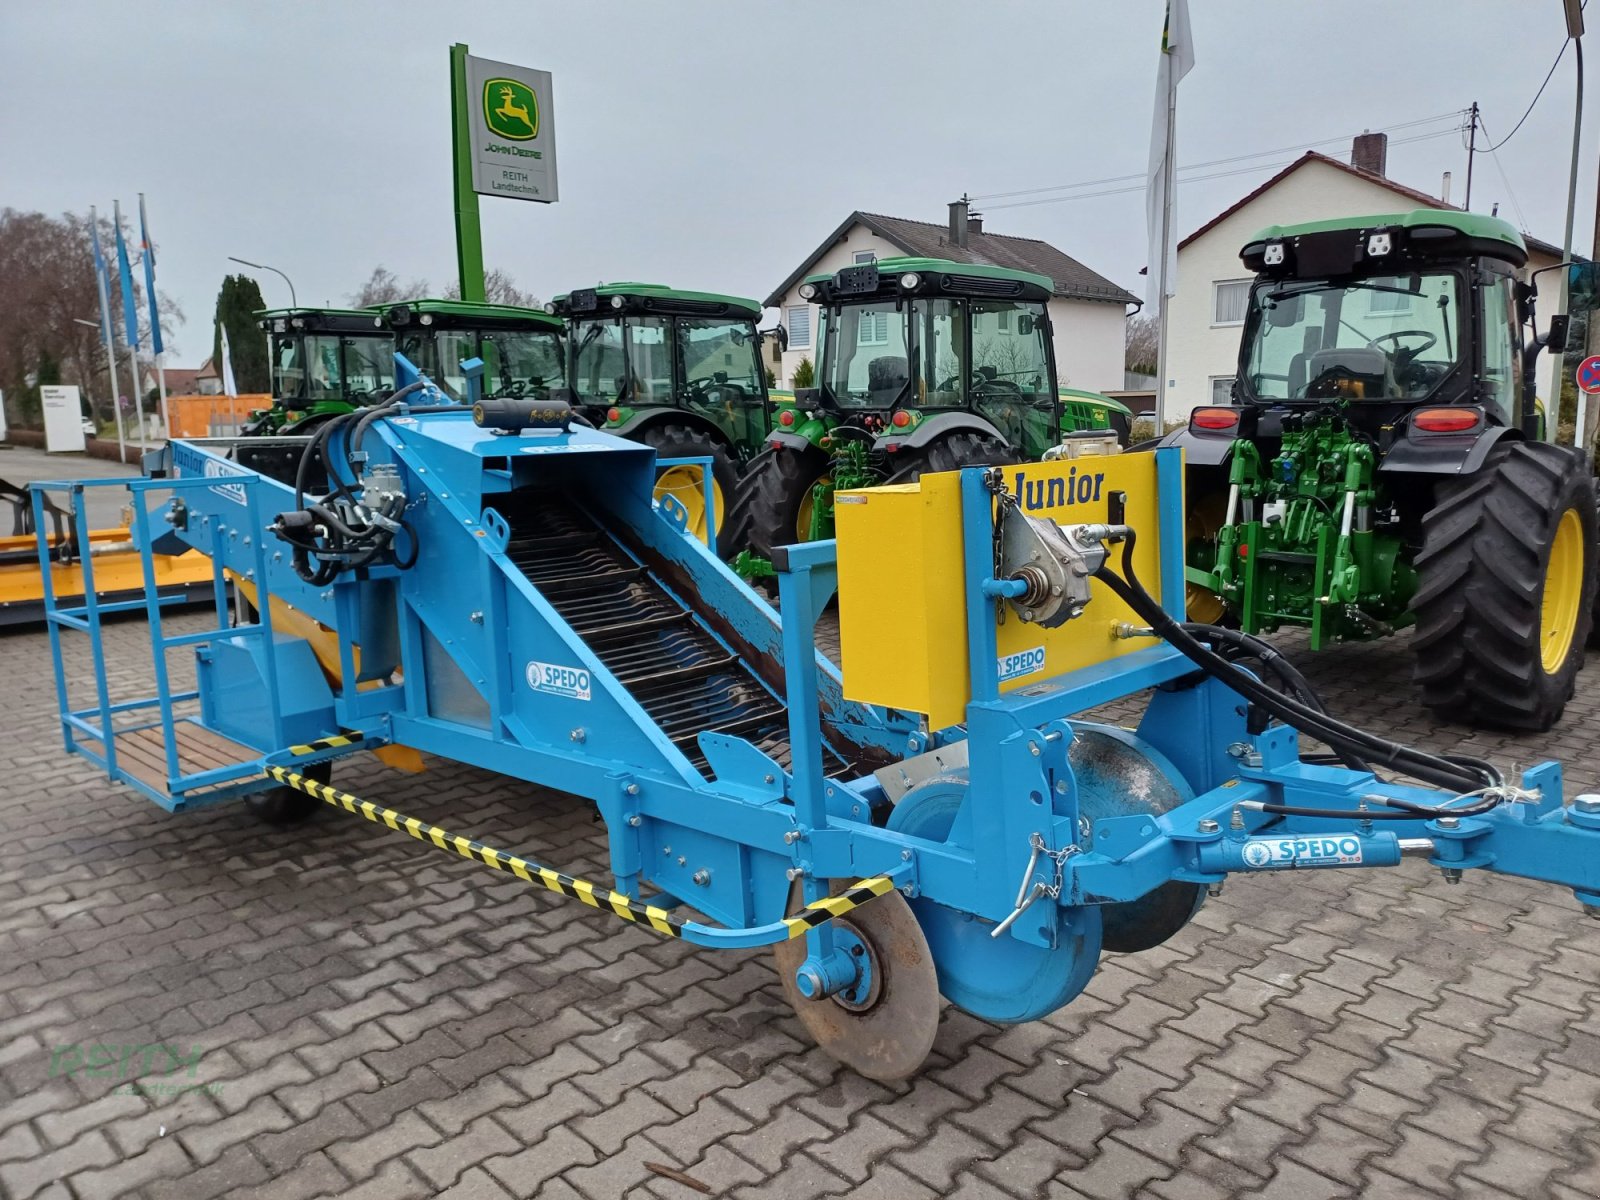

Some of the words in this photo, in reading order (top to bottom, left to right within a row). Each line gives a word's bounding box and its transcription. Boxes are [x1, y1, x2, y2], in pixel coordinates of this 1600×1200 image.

[485, 142, 511, 155] JOHN
[511, 146, 542, 160] DEERE
[492, 180, 540, 195] Landtechnik
[502, 170, 529, 183] REITH
[174, 443, 204, 474] Junior
[1015, 466, 1105, 511] Junior
[1005, 648, 1044, 674] SPEDO
[545, 666, 589, 691] SPEDO
[1279, 838, 1360, 859] SPEDO
